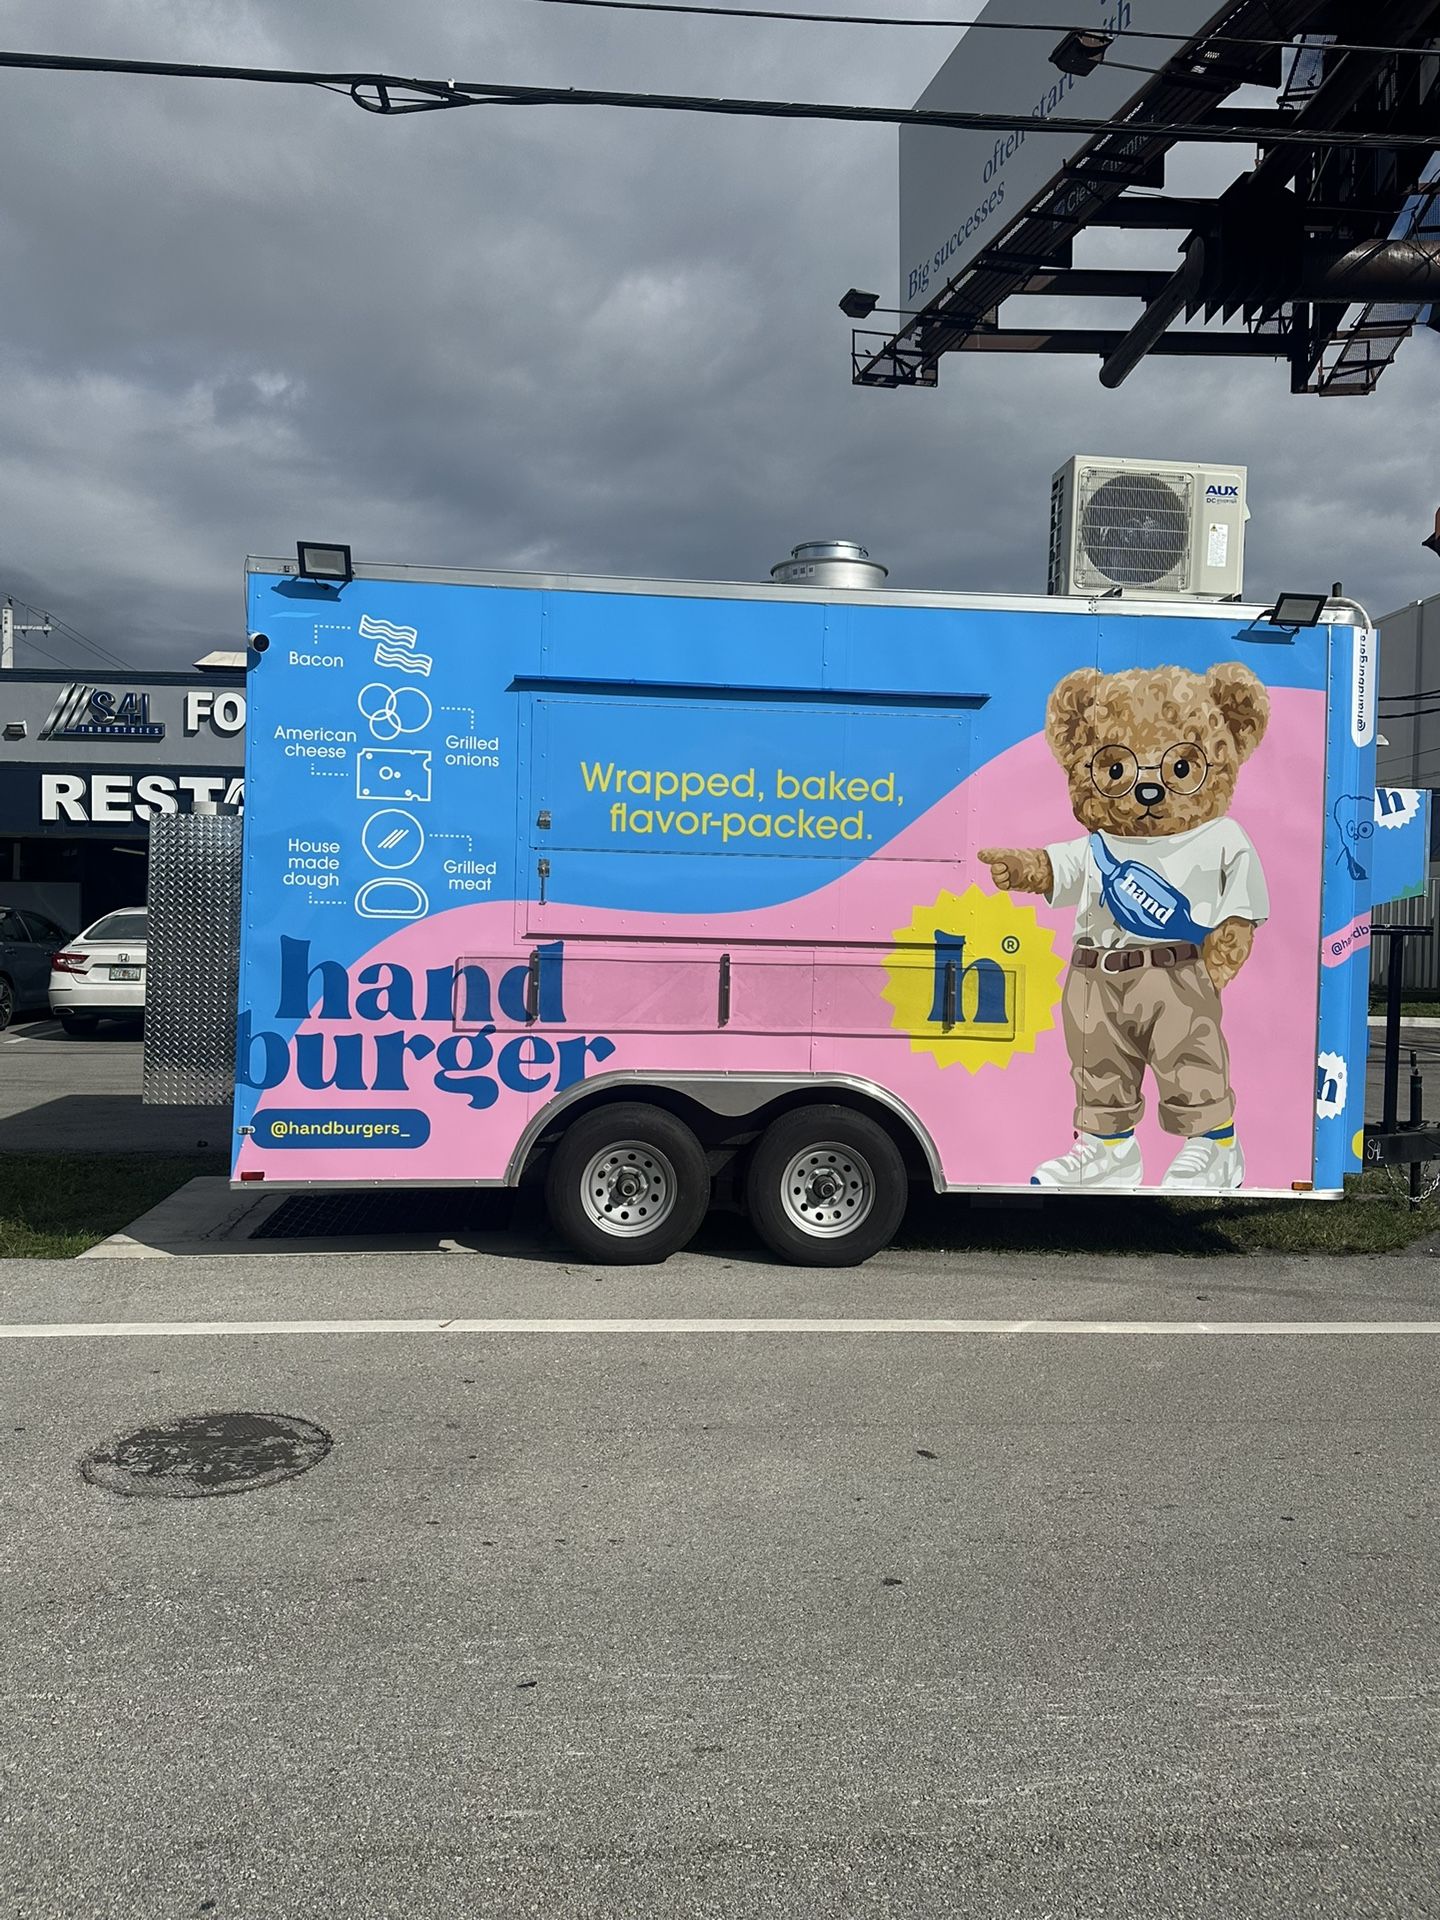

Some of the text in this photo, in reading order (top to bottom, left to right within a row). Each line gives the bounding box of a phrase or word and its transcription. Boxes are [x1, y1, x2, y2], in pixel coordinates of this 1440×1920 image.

[908, 181, 1005, 300] Big successes
[1205, 485, 1239, 496] AUX
[289, 651, 344, 667] Bacon
[274, 725, 357, 743] American
[445, 734, 499, 751] Grilled
[284, 743, 347, 759] cheese
[445, 751, 500, 768] onions
[580, 761, 905, 807] Wrapped, baked,
[1376, 788, 1406, 817] h
[610, 802, 874, 843] flavor-packed.
[288, 838, 340, 854] House
[288, 855, 340, 871] made
[443, 859, 497, 876] Grilled
[283, 872, 340, 889] dough
[448, 877, 492, 892] meat
[1118, 874, 1176, 926] hand
[274, 934, 567, 1024] hand
[927, 929, 1009, 1024] h
[235, 1009, 617, 1111] burger
[270, 1119, 411, 1139] @handburgers_
